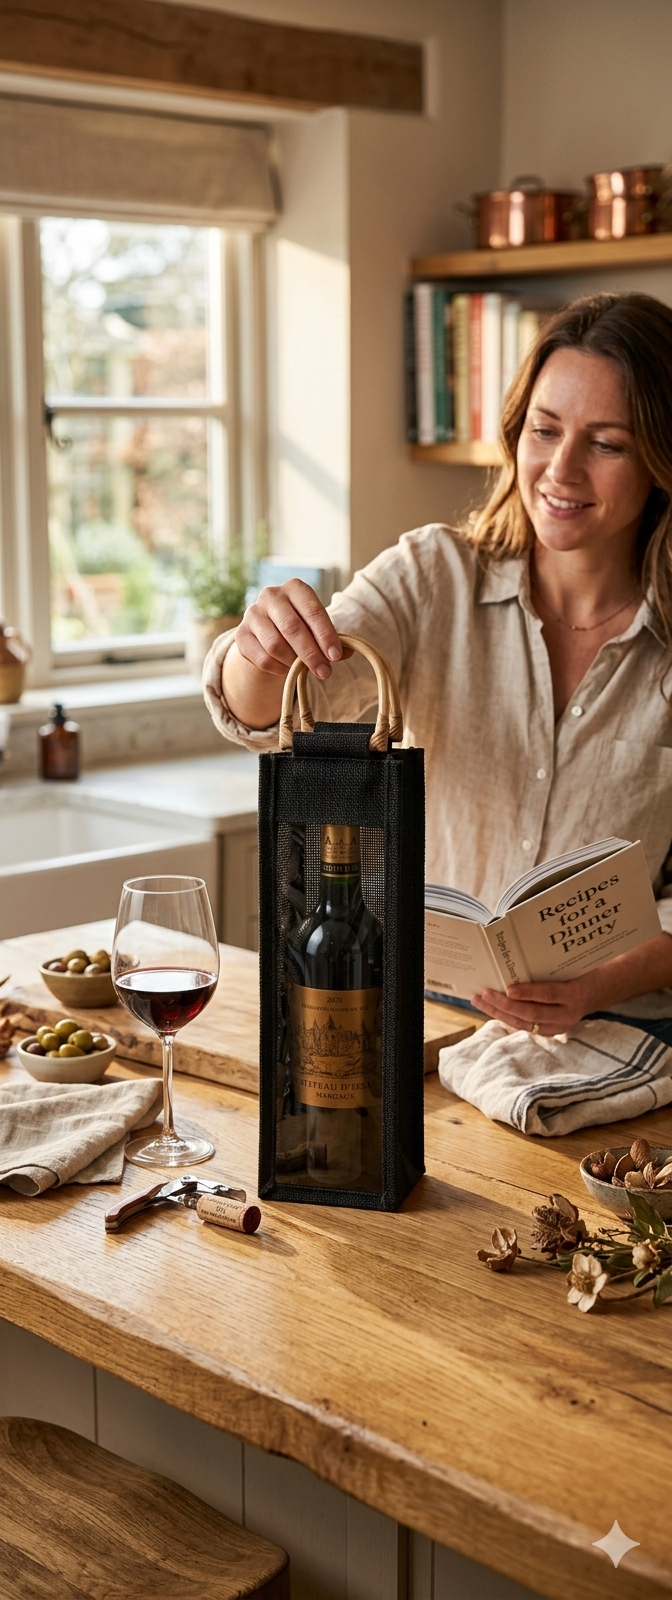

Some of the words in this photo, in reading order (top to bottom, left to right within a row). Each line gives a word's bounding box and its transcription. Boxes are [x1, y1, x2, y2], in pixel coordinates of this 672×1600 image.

[538, 875, 619, 922] Recipes
[559, 905, 589, 926] for
[595, 898, 607, 909] a
[549, 903, 621, 946] Dinner
[562, 919, 617, 953] Party
